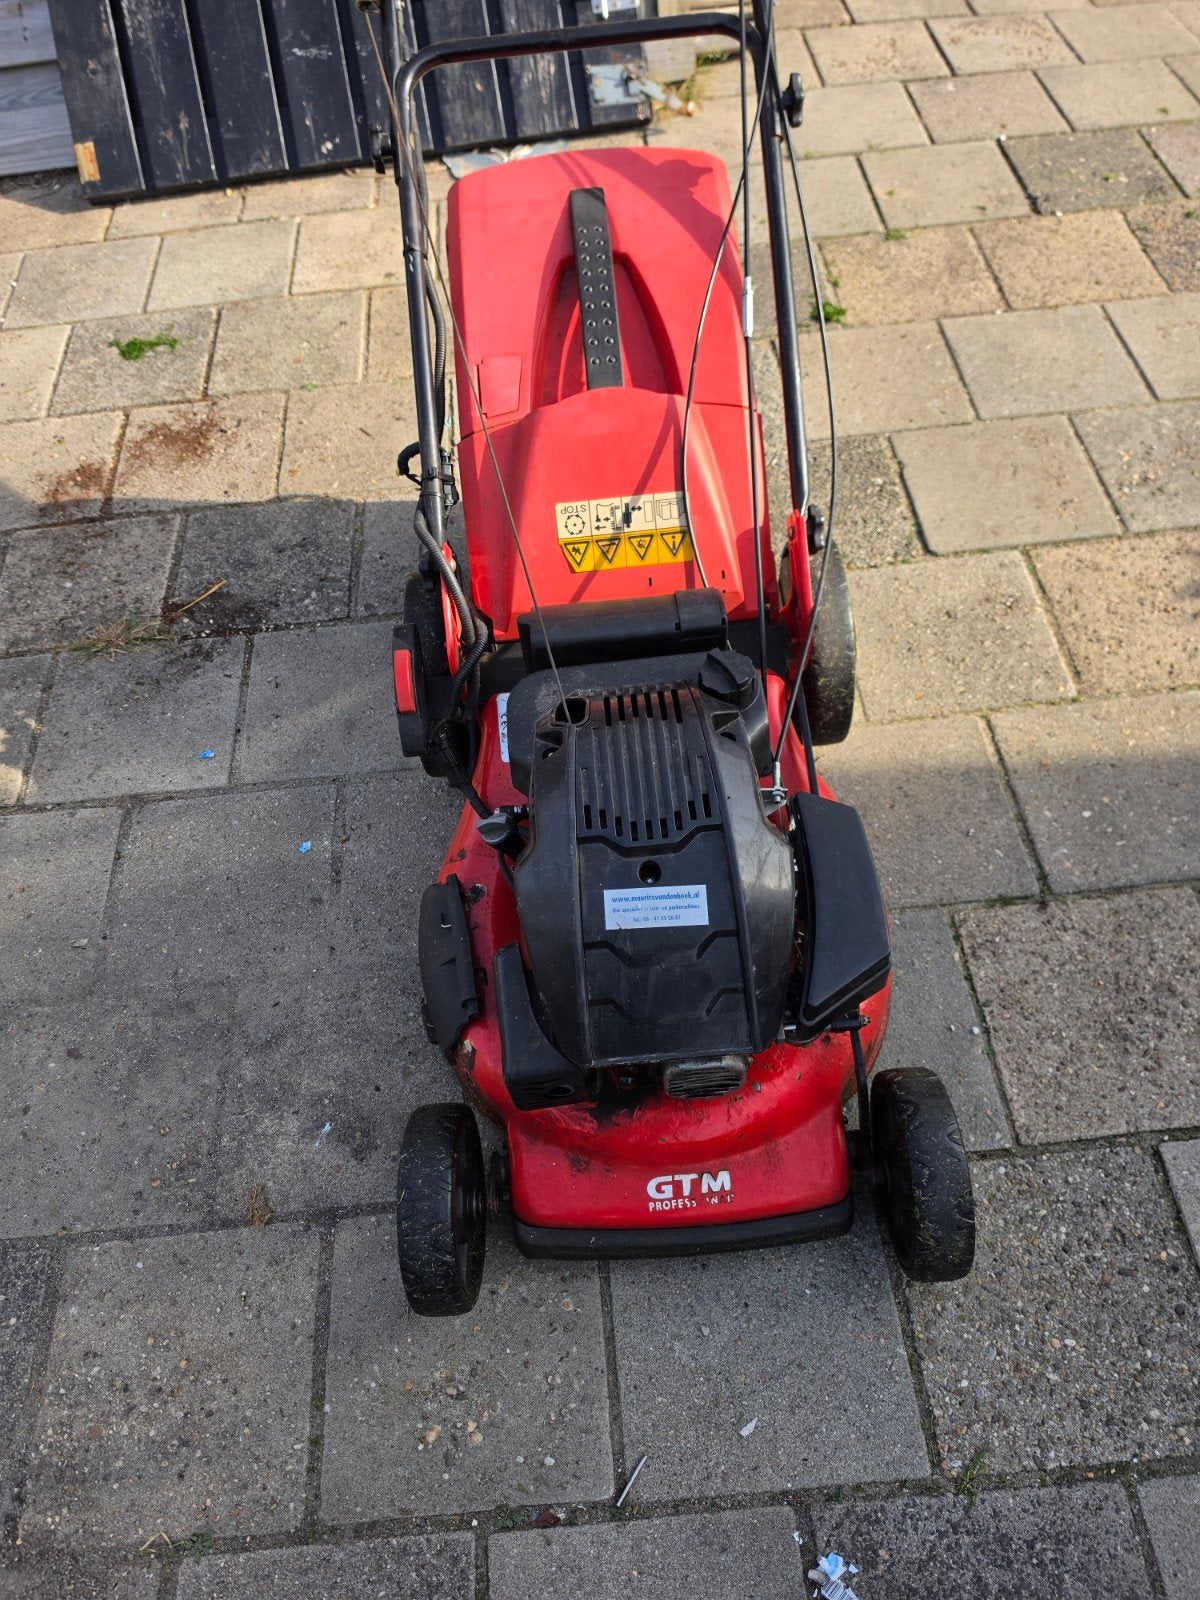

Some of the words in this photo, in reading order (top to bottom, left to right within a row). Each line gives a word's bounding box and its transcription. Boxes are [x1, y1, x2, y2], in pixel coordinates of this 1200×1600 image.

[560, 504, 587, 515] STOP
[611, 891, 700, 902] www.mauritsvandenhoek.nl
[646, 1170, 732, 1200] GTM
